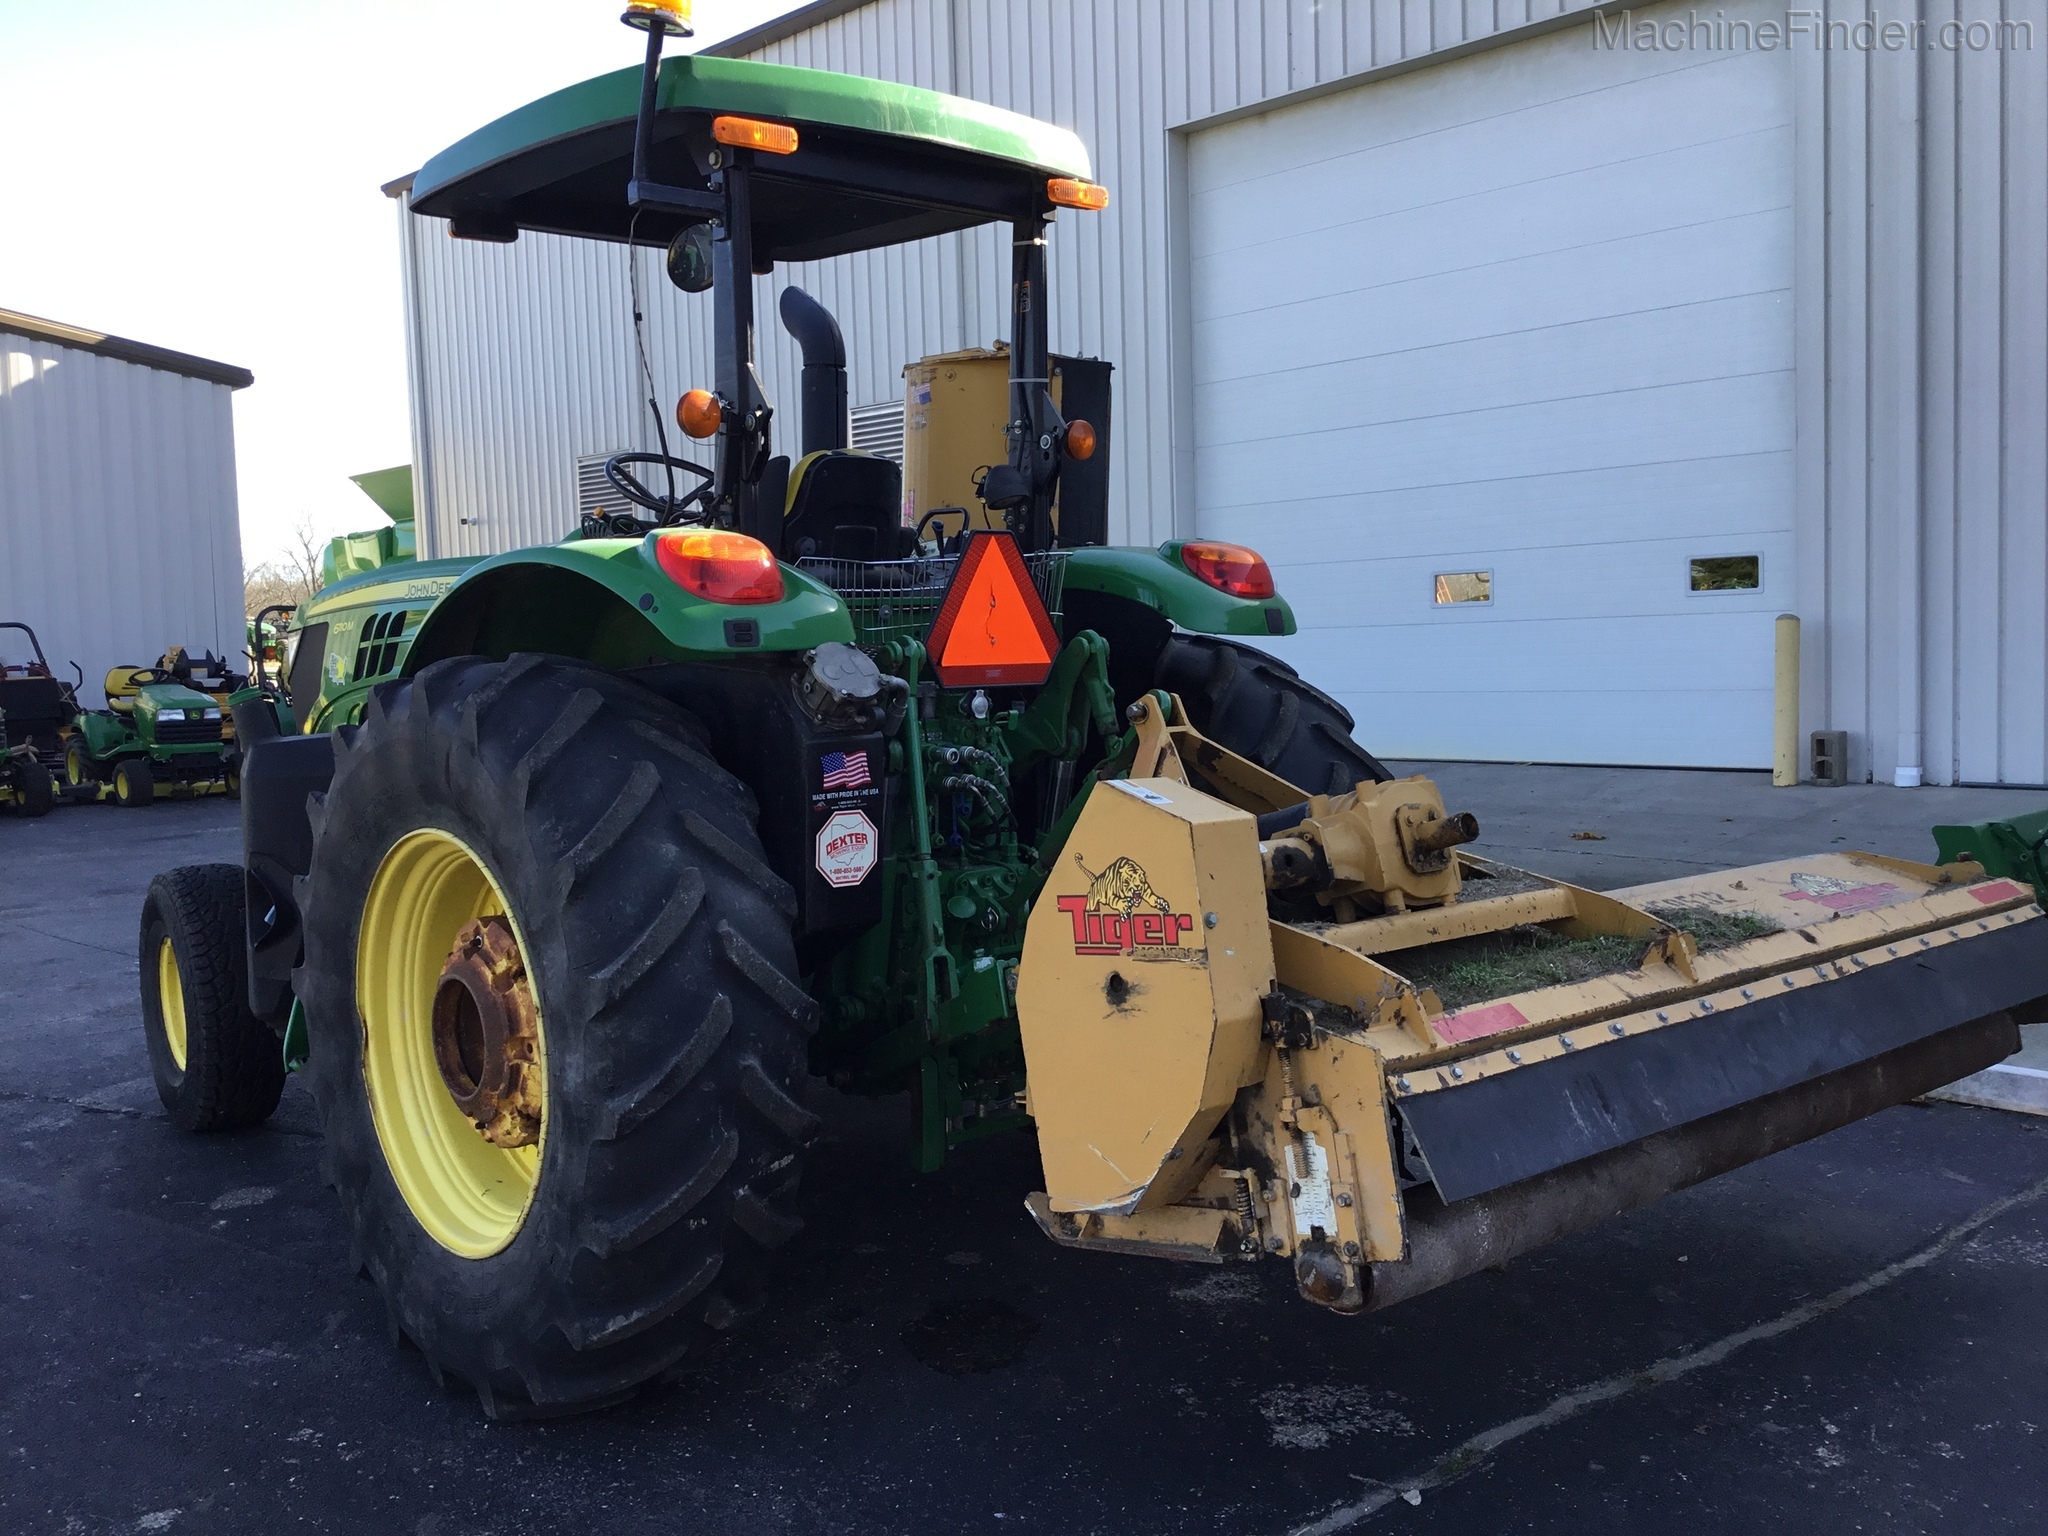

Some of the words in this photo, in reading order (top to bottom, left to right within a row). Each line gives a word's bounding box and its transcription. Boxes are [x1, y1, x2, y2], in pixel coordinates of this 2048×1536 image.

[404, 583, 430, 599] JOHN
[431, 580, 451, 597] DEE
[813, 793, 826, 801] MADE
[827, 792, 838, 800] WITH
[826, 832, 869, 856] DEXTER
[1057, 895, 1193, 956] Tiger
